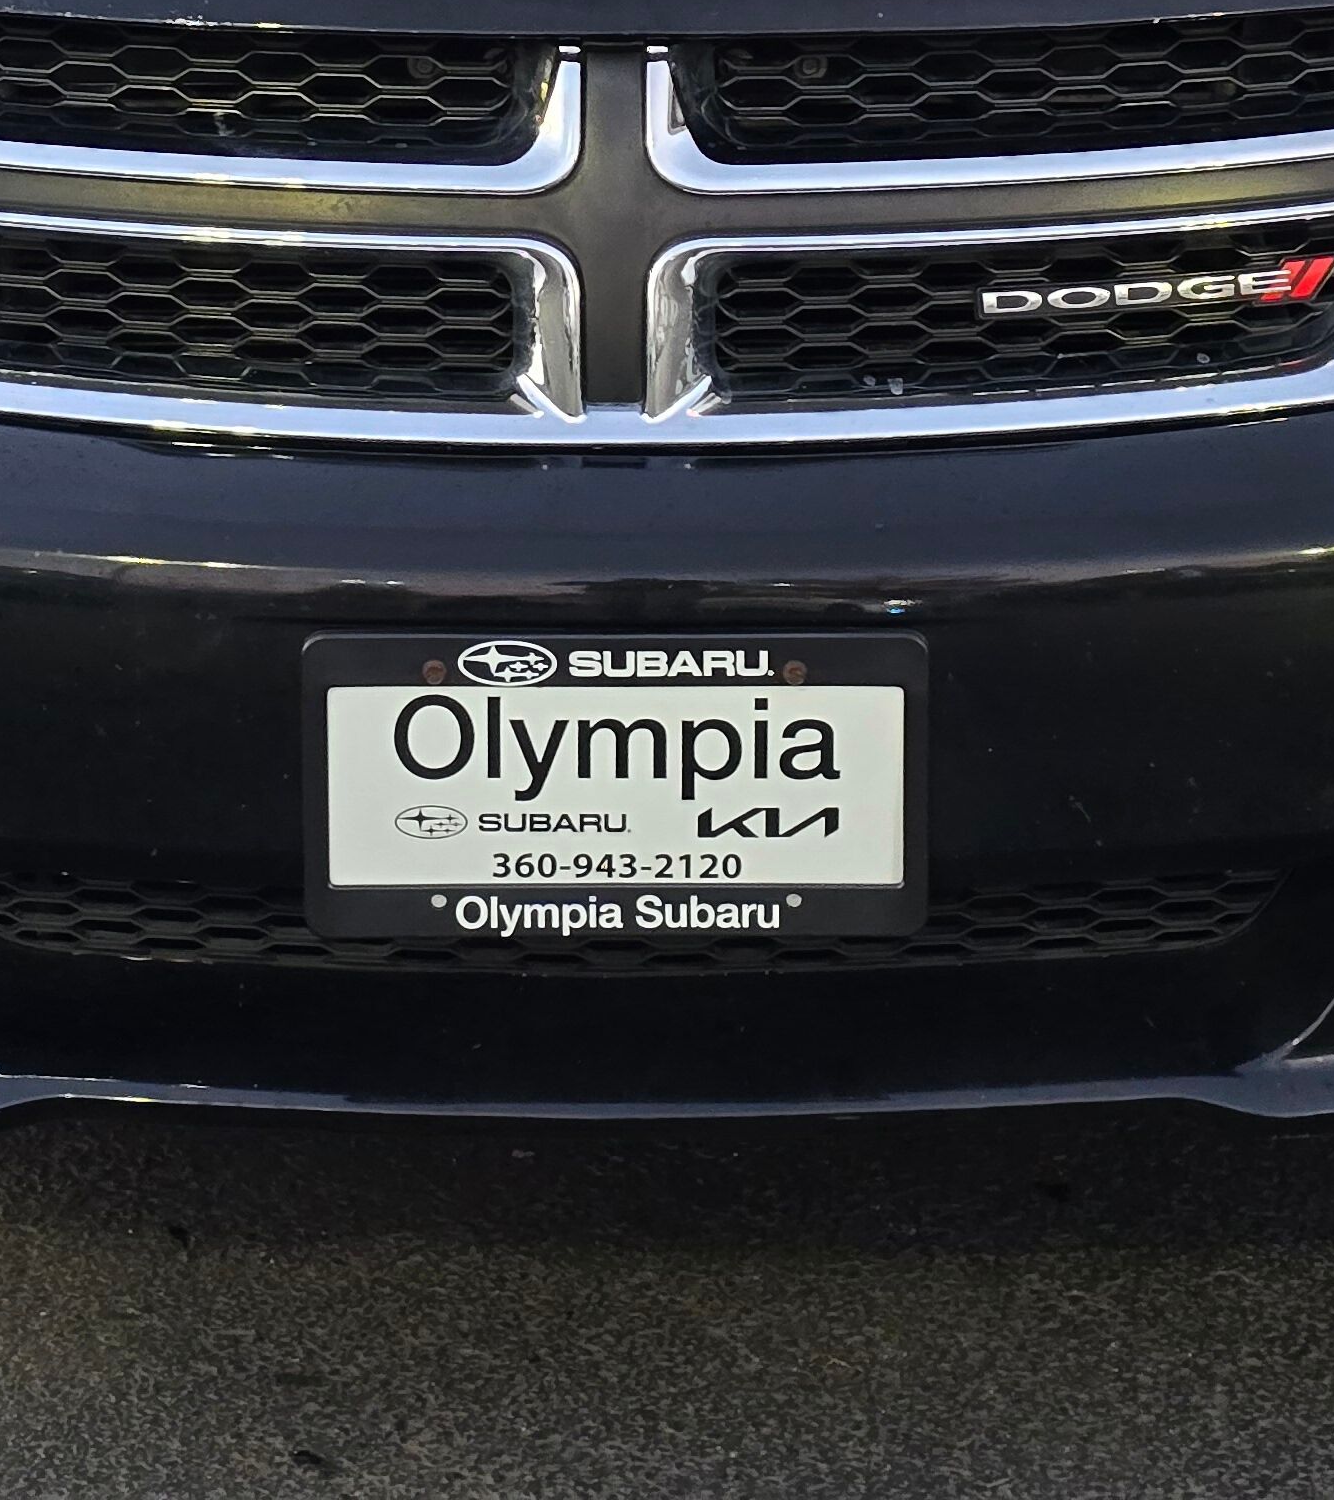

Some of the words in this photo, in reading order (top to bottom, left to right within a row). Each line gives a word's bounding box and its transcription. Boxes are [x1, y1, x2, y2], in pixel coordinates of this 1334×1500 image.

[981, 269, 1293, 315] DODGE
[393, 694, 842, 802] Olympia
[478, 813, 628, 833] SUBARU
[492, 852, 742, 879] 360-943-2120
[455, 894, 624, 938] Olympia
[635, 894, 780, 929] Subaru
